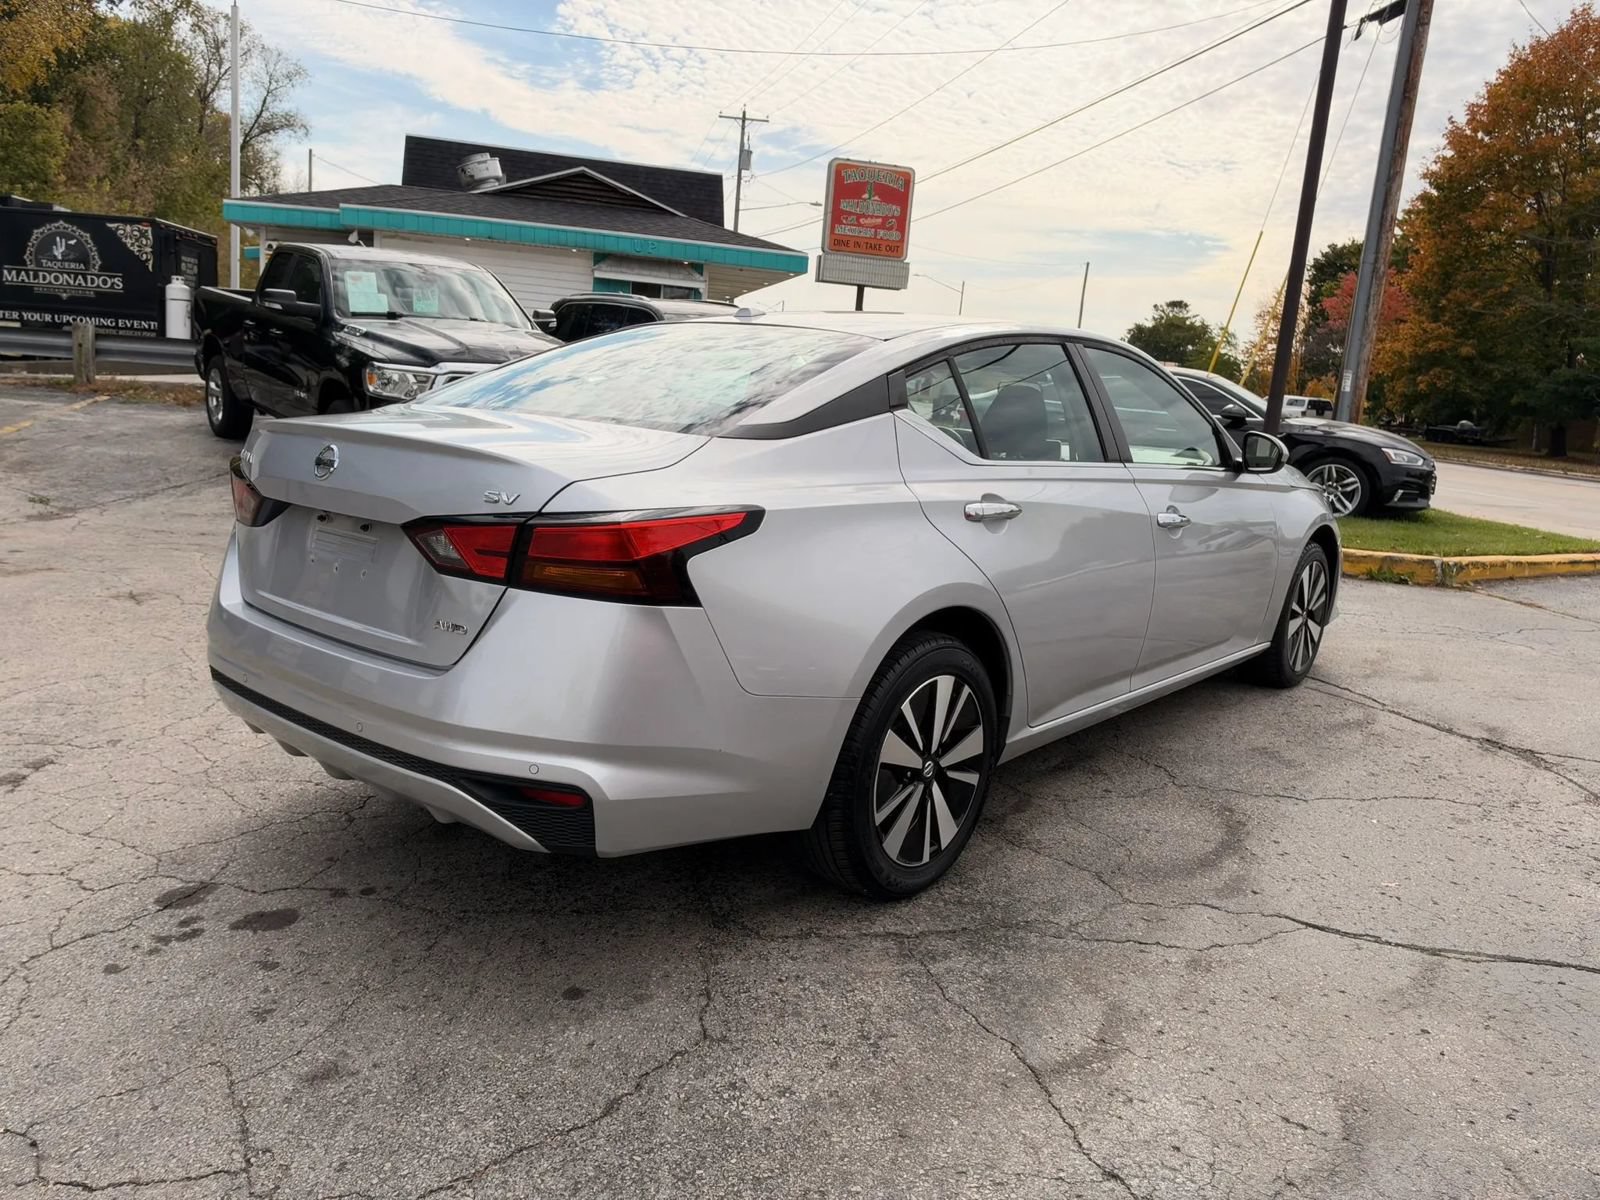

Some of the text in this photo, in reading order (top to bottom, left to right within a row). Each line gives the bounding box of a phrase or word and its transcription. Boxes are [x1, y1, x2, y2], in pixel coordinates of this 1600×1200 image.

[842, 167, 904, 192] TAQUERIA
[835, 225, 901, 241] MEXICAN FOOD
[833, 238, 851, 248] DINE
[885, 244, 900, 253] OUT
[41, 259, 85, 270] TAQUERIA
[2, 269, 123, 289] MALDONADO'S
[21, 311, 52, 322] YOUR
[54, 314, 116, 327] UPCOMING
[118, 319, 158, 330] EVENT!
[483, 490, 521, 506] SV
[432, 619, 468, 636] AWD
